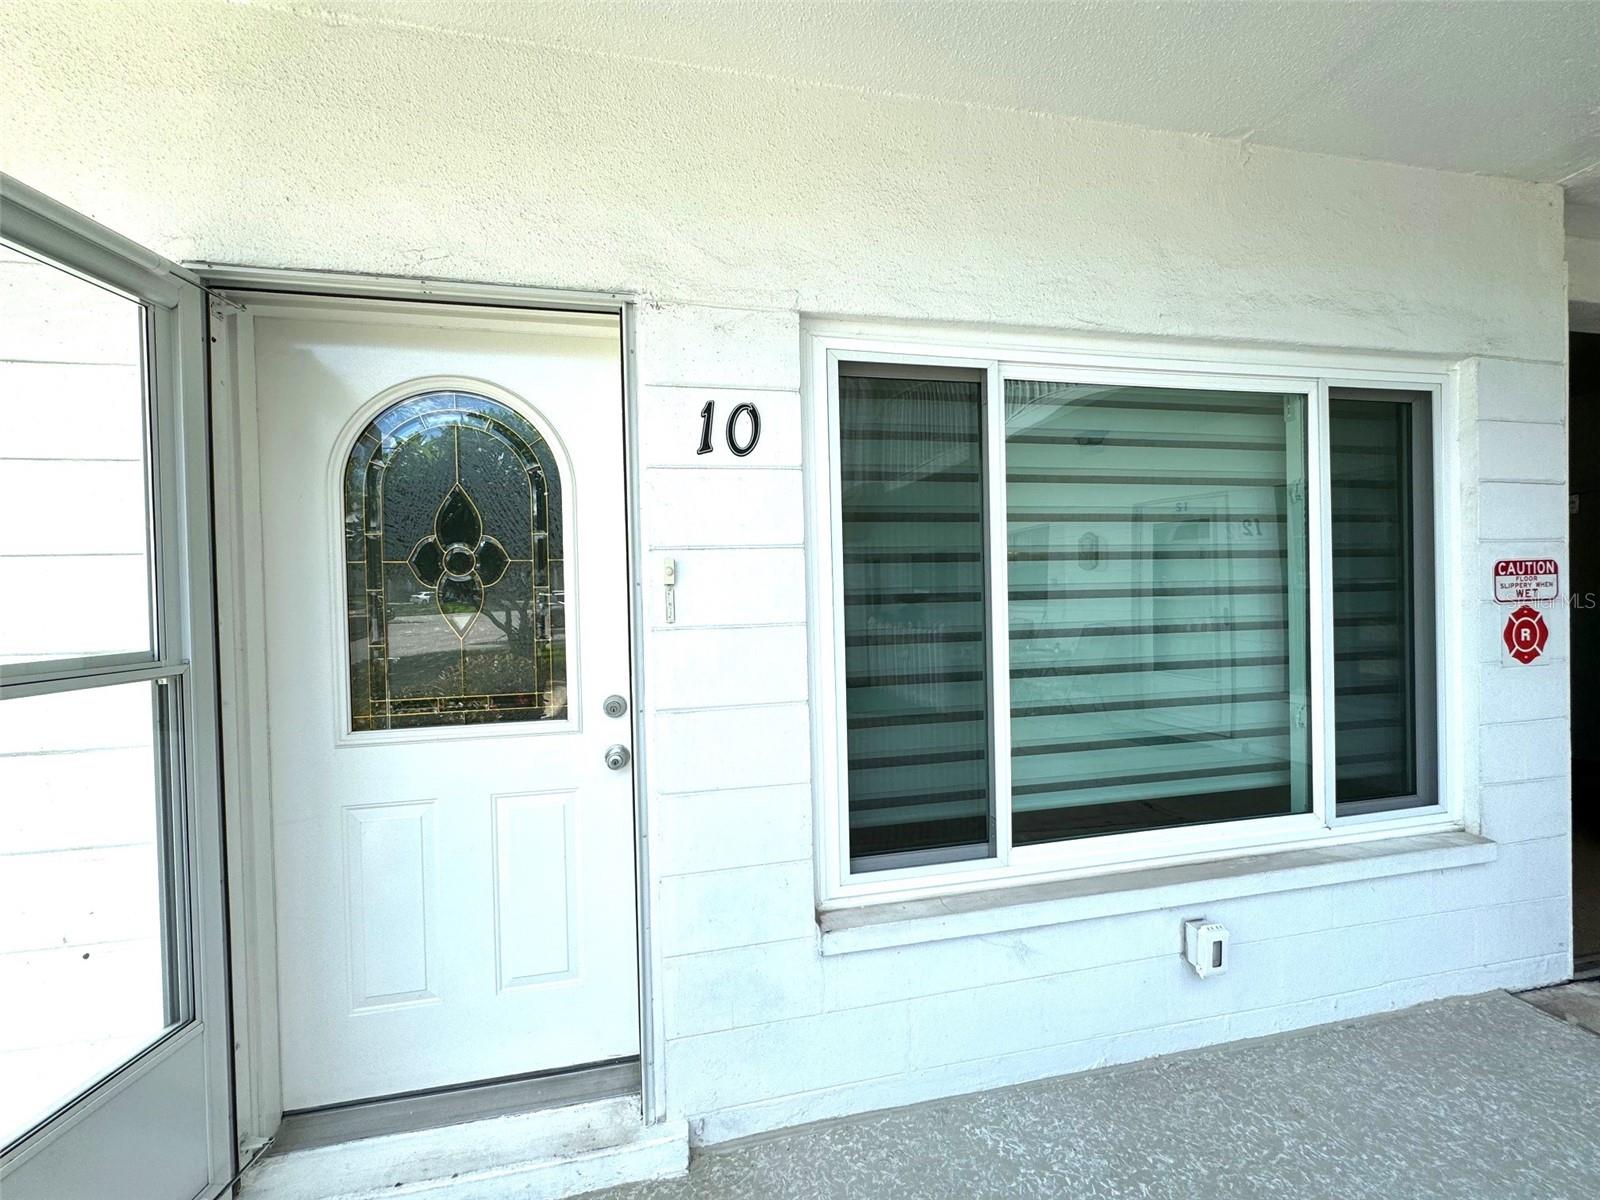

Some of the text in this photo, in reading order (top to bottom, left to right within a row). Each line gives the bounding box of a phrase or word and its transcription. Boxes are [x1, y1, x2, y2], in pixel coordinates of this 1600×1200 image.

[697, 400, 761, 457] 10
[1498, 561, 1555, 575] CAUTION
[1516, 588, 1538, 598] WET
[1520, 628, 1531, 641] R
